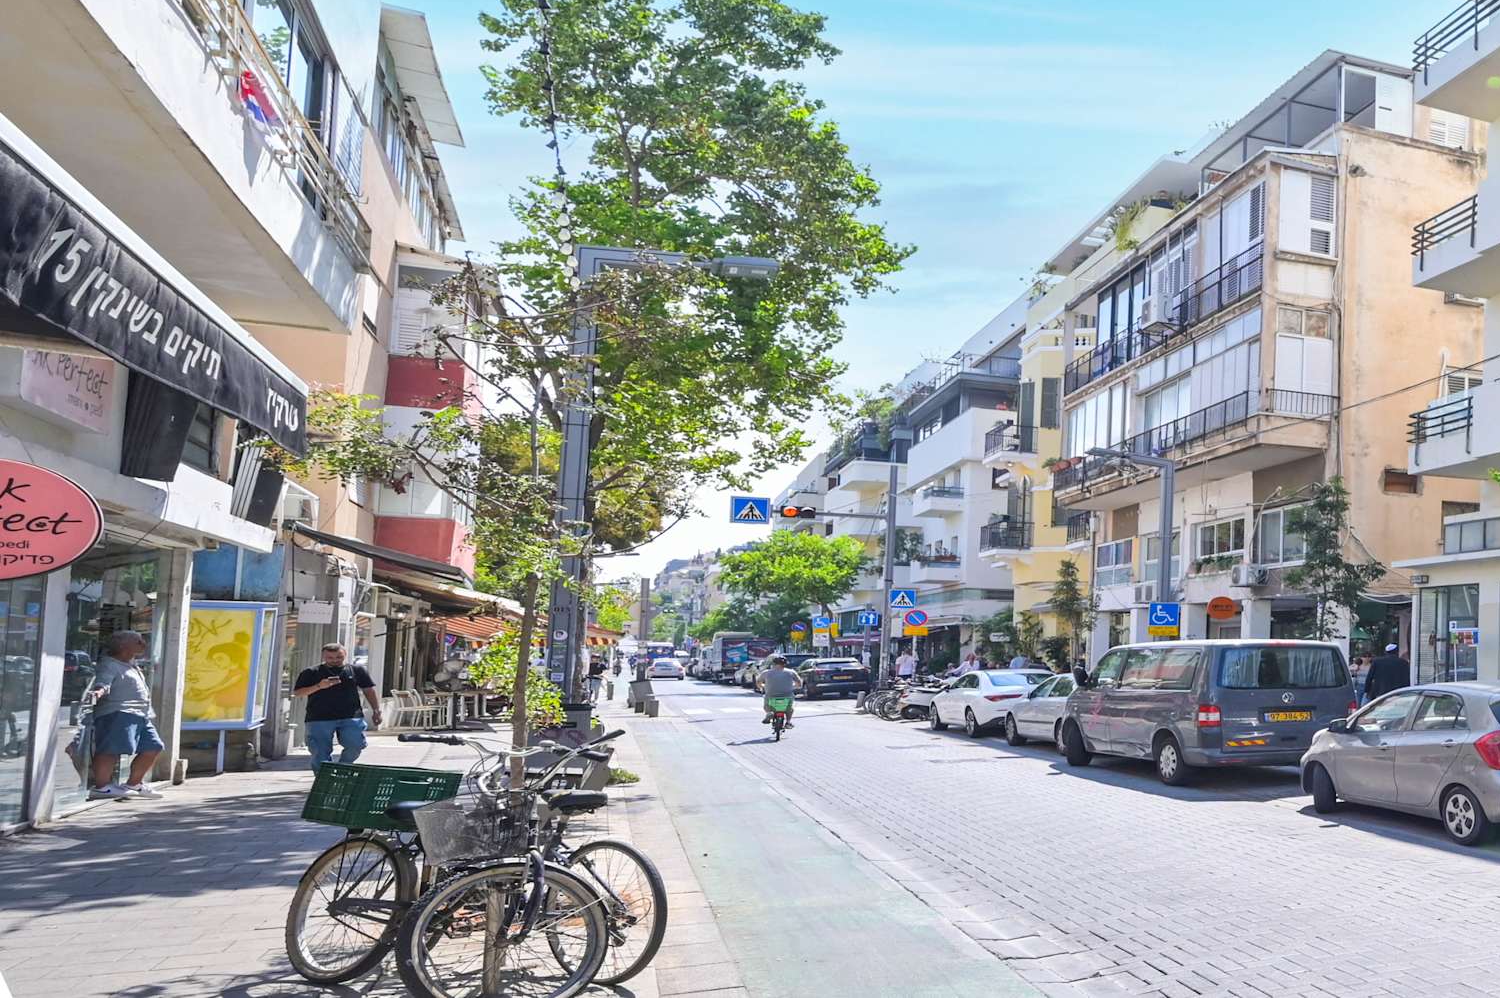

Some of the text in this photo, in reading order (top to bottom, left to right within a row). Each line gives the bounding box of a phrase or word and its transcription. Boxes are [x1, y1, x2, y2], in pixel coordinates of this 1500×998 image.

[37, 228, 93, 284] 15
[71, 266, 165, 345] בשינקין
[164, 326, 222, 380] תיקים
